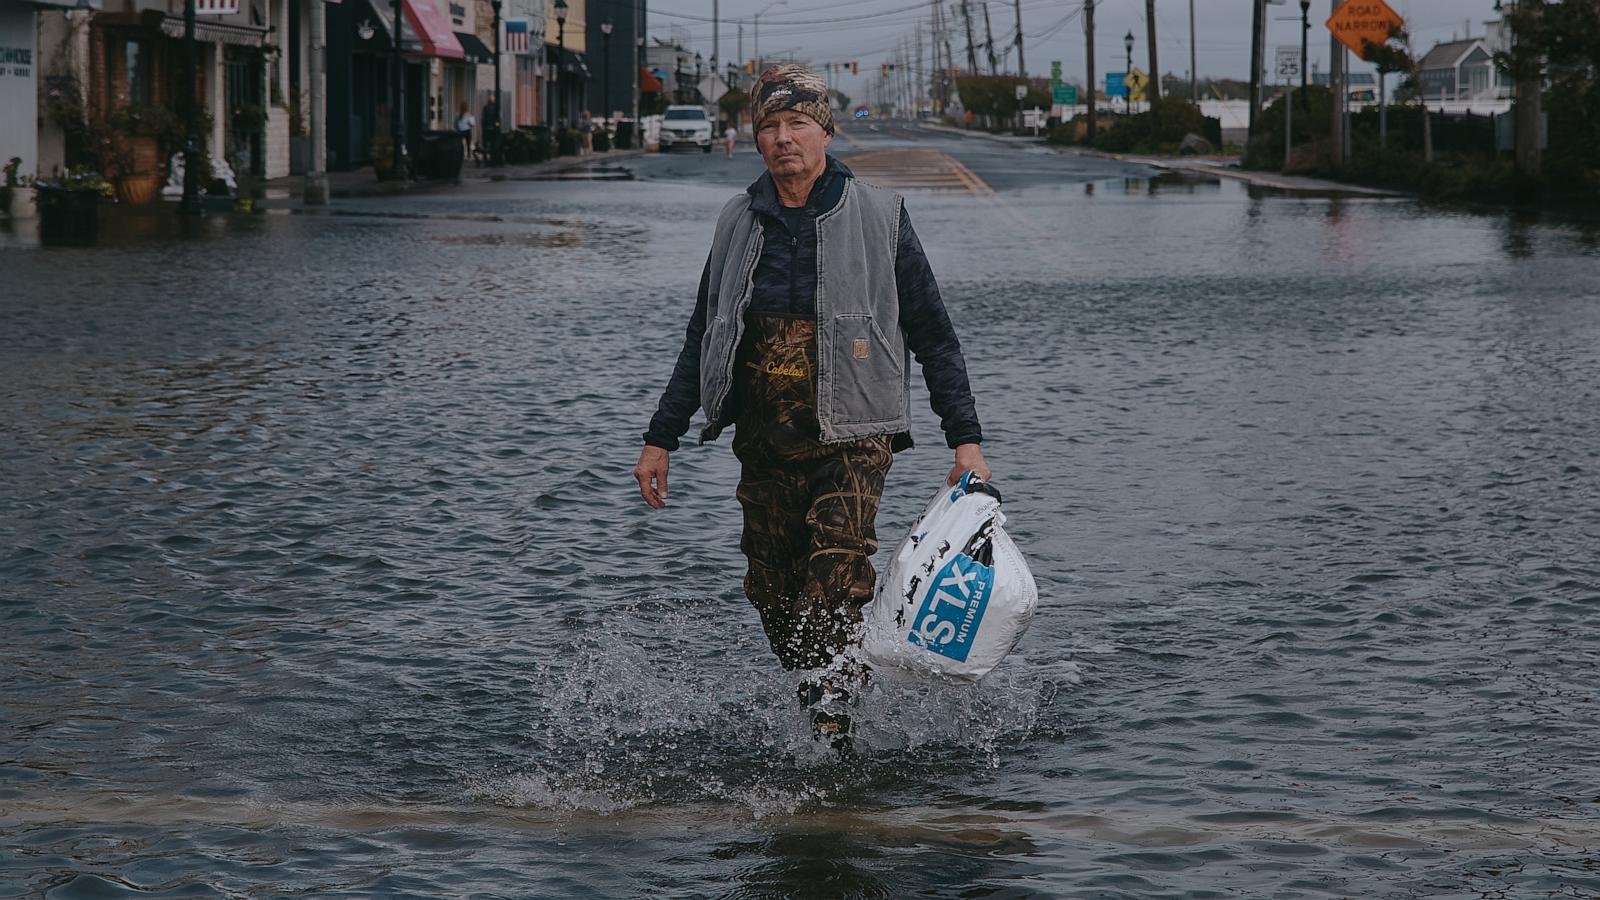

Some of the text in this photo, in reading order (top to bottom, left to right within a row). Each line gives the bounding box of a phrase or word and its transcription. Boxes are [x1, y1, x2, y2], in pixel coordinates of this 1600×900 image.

[1348, 5, 1381, 16] ROAD
[1335, 20, 1391, 32] NARROW
[1280, 63, 1298, 75] 25
[920, 561, 977, 645] XLS
[956, 580, 986, 644] PREMIUM
